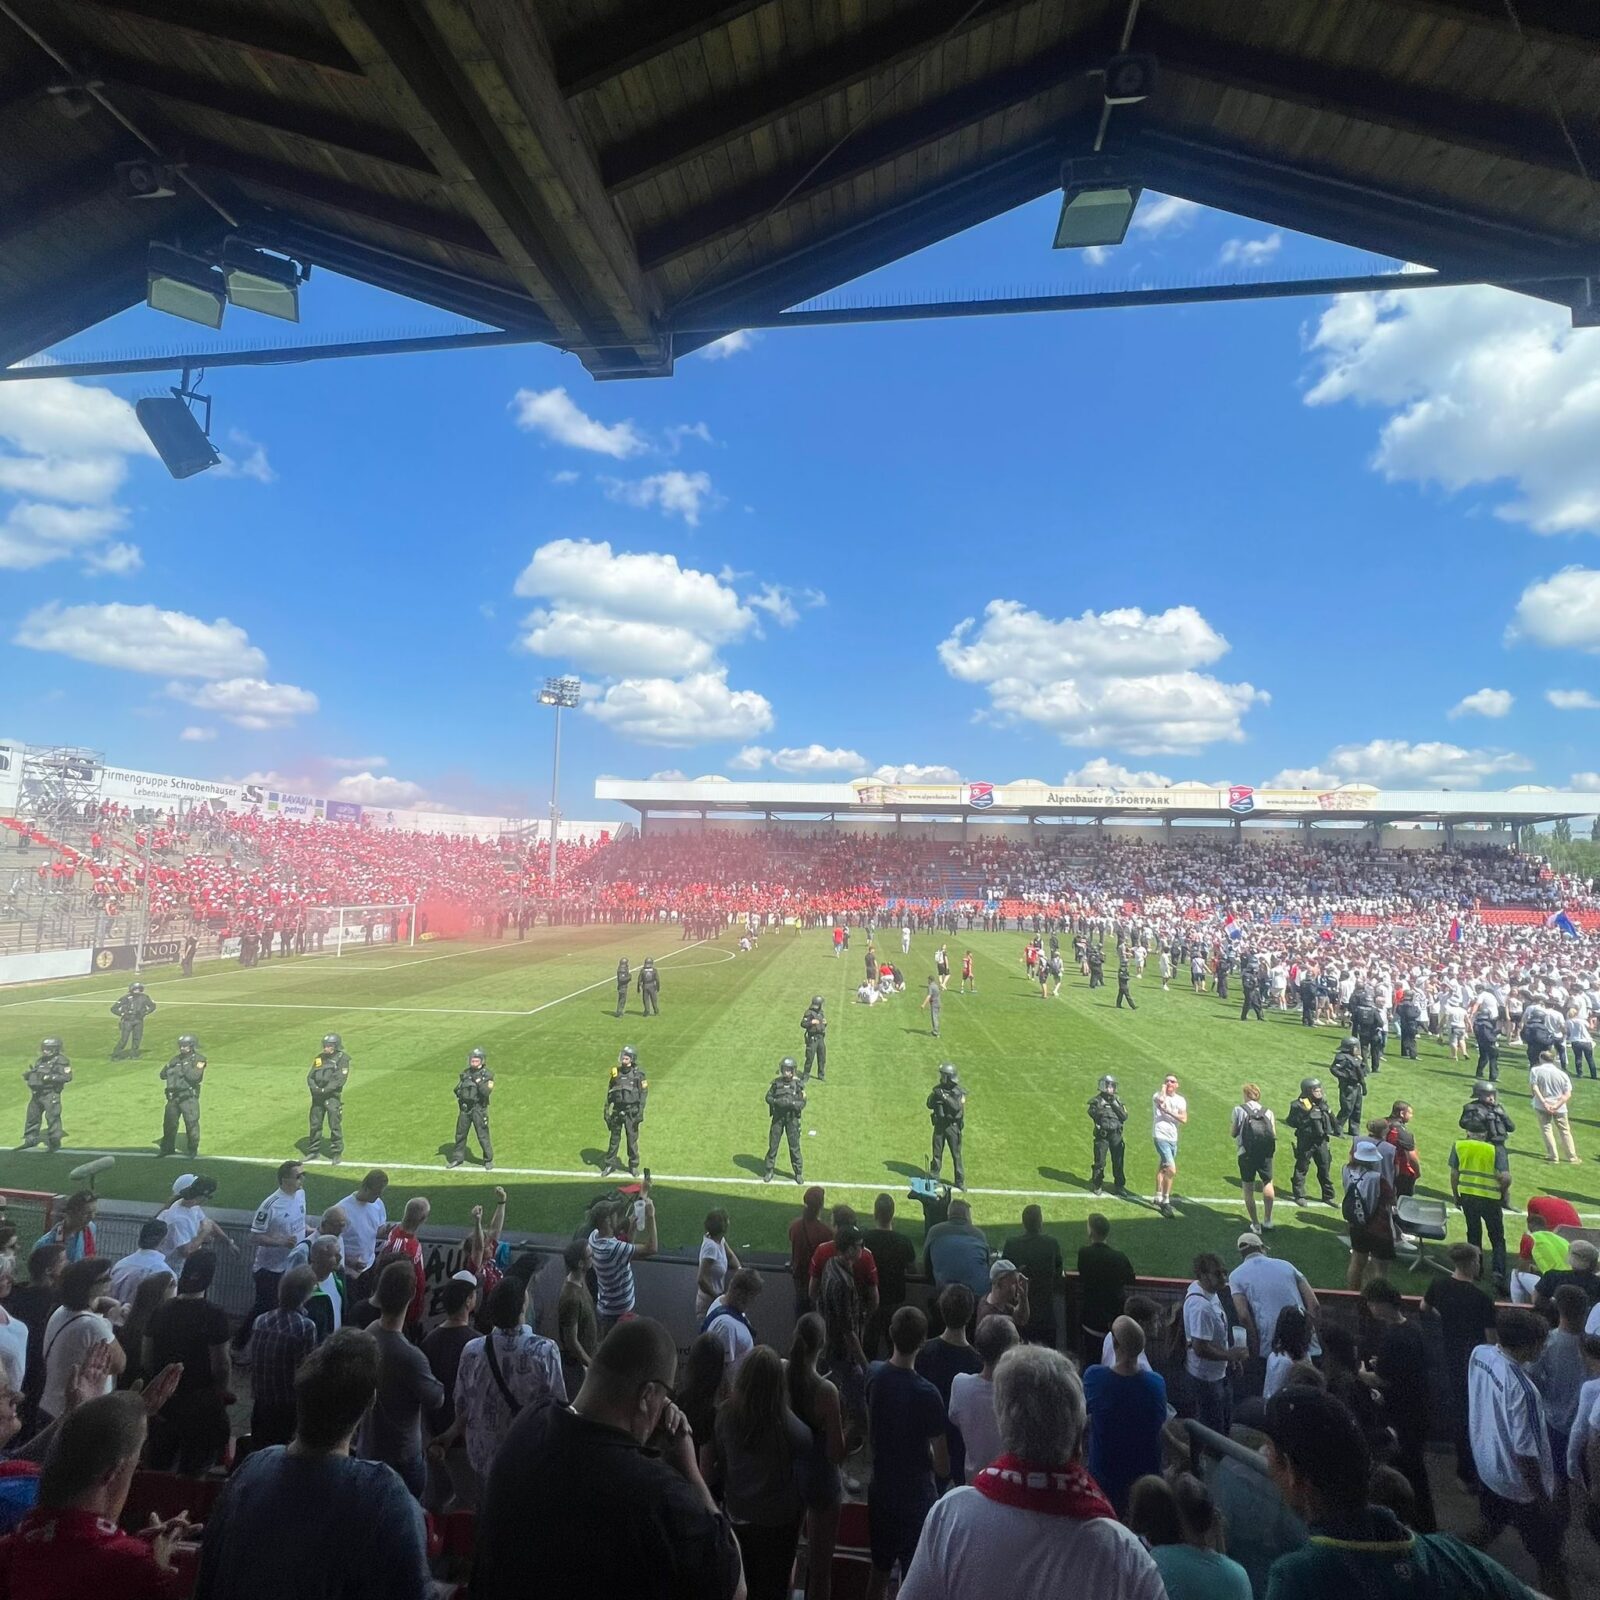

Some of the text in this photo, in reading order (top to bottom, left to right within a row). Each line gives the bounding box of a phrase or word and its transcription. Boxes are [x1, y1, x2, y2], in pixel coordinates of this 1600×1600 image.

[102, 769, 237, 796] Firmengruppe Schrobenhauser
[281, 794, 313, 806] BAVARIA
[1047, 793, 1170, 805] Alpenbauer SPORTPARK
[284, 804, 307, 815] petrol
[133, 943, 181, 957] VINOD
